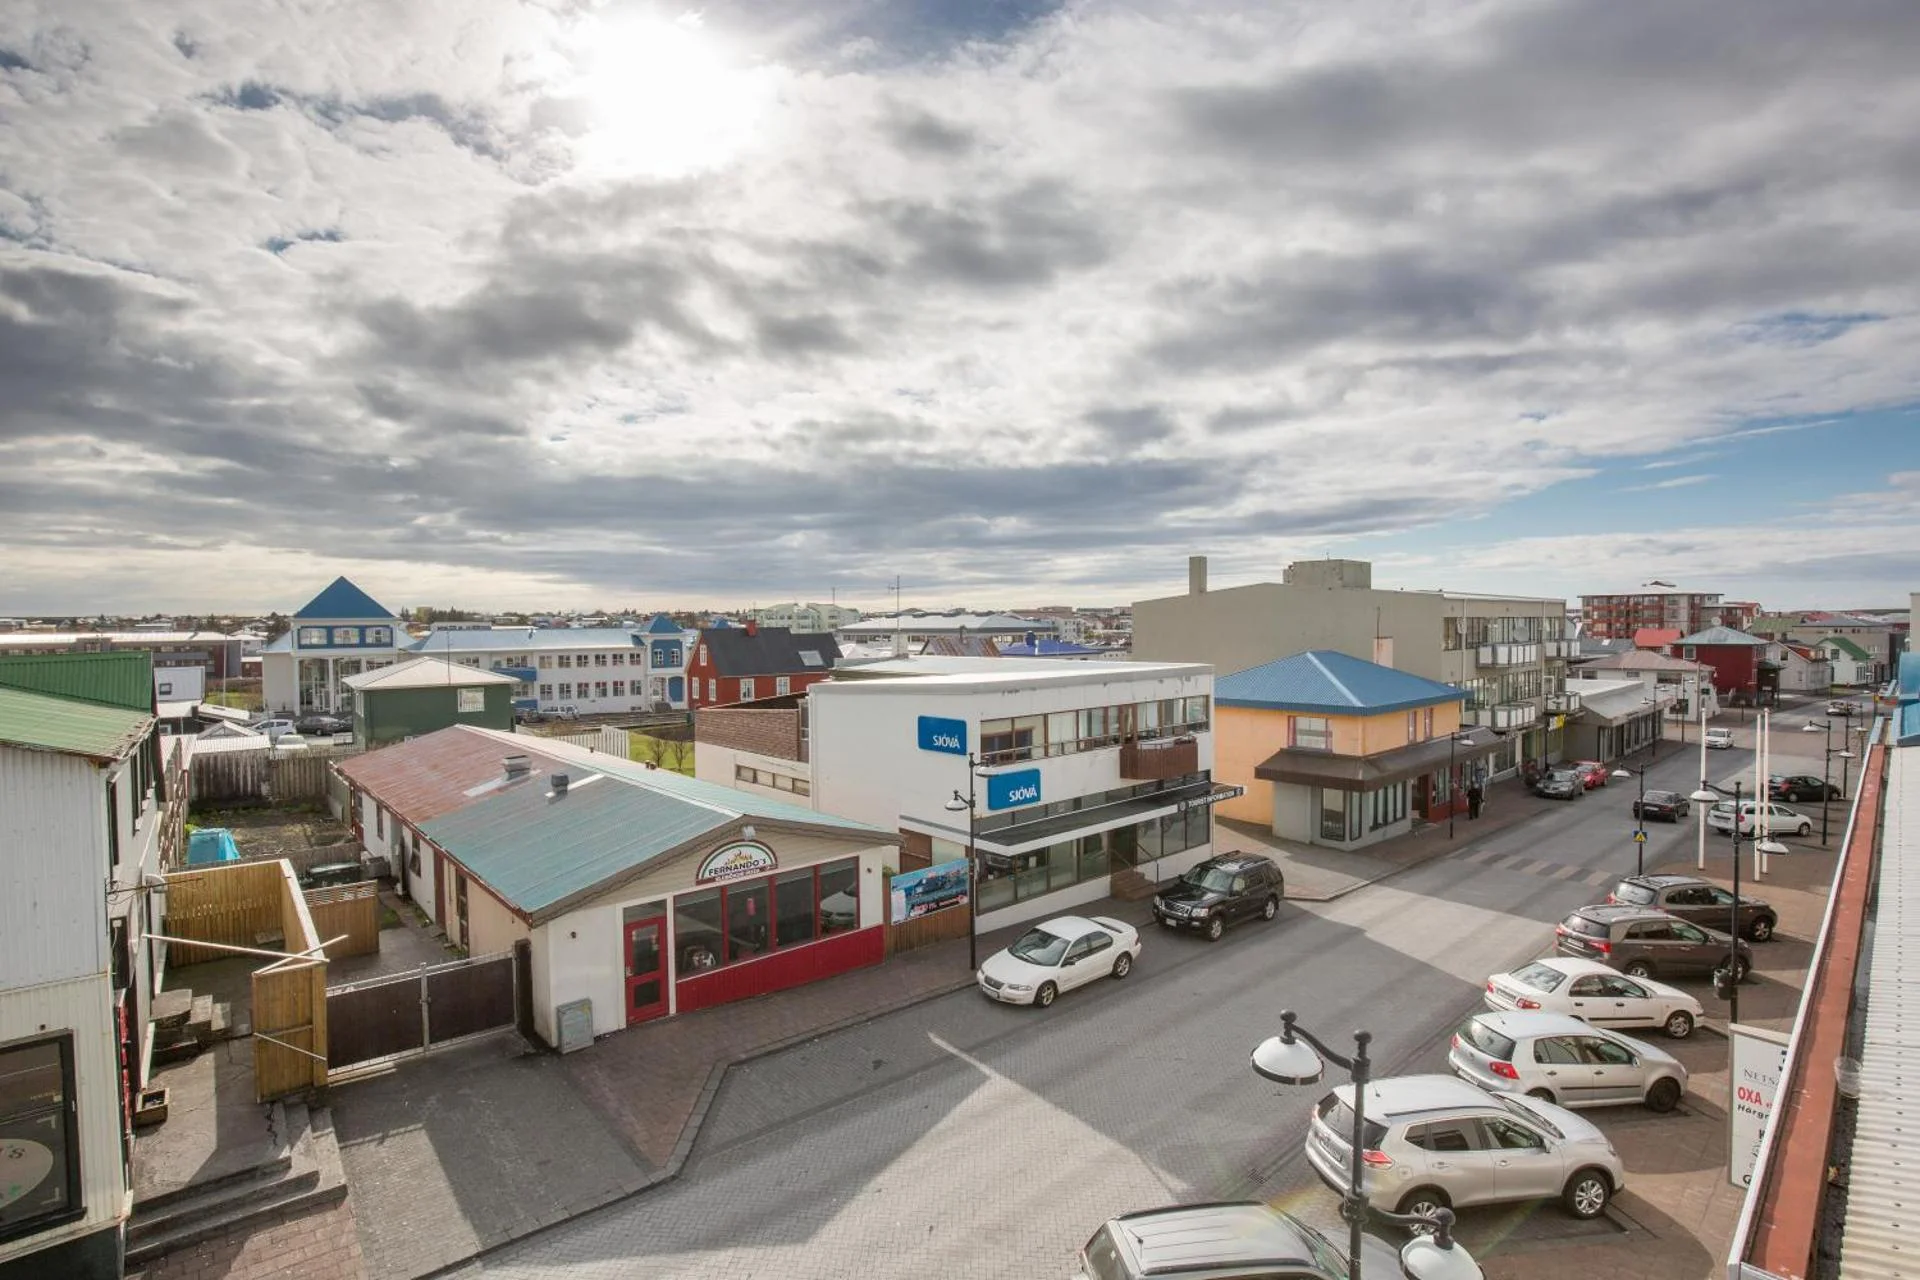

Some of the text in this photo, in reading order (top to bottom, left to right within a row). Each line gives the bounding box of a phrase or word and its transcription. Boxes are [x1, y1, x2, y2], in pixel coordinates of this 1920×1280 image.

[932, 733, 960, 749] SJÓVÁ
[1009, 784, 1038, 802] SJÓVÁ
[1738, 1086, 1762, 1106] OXA
